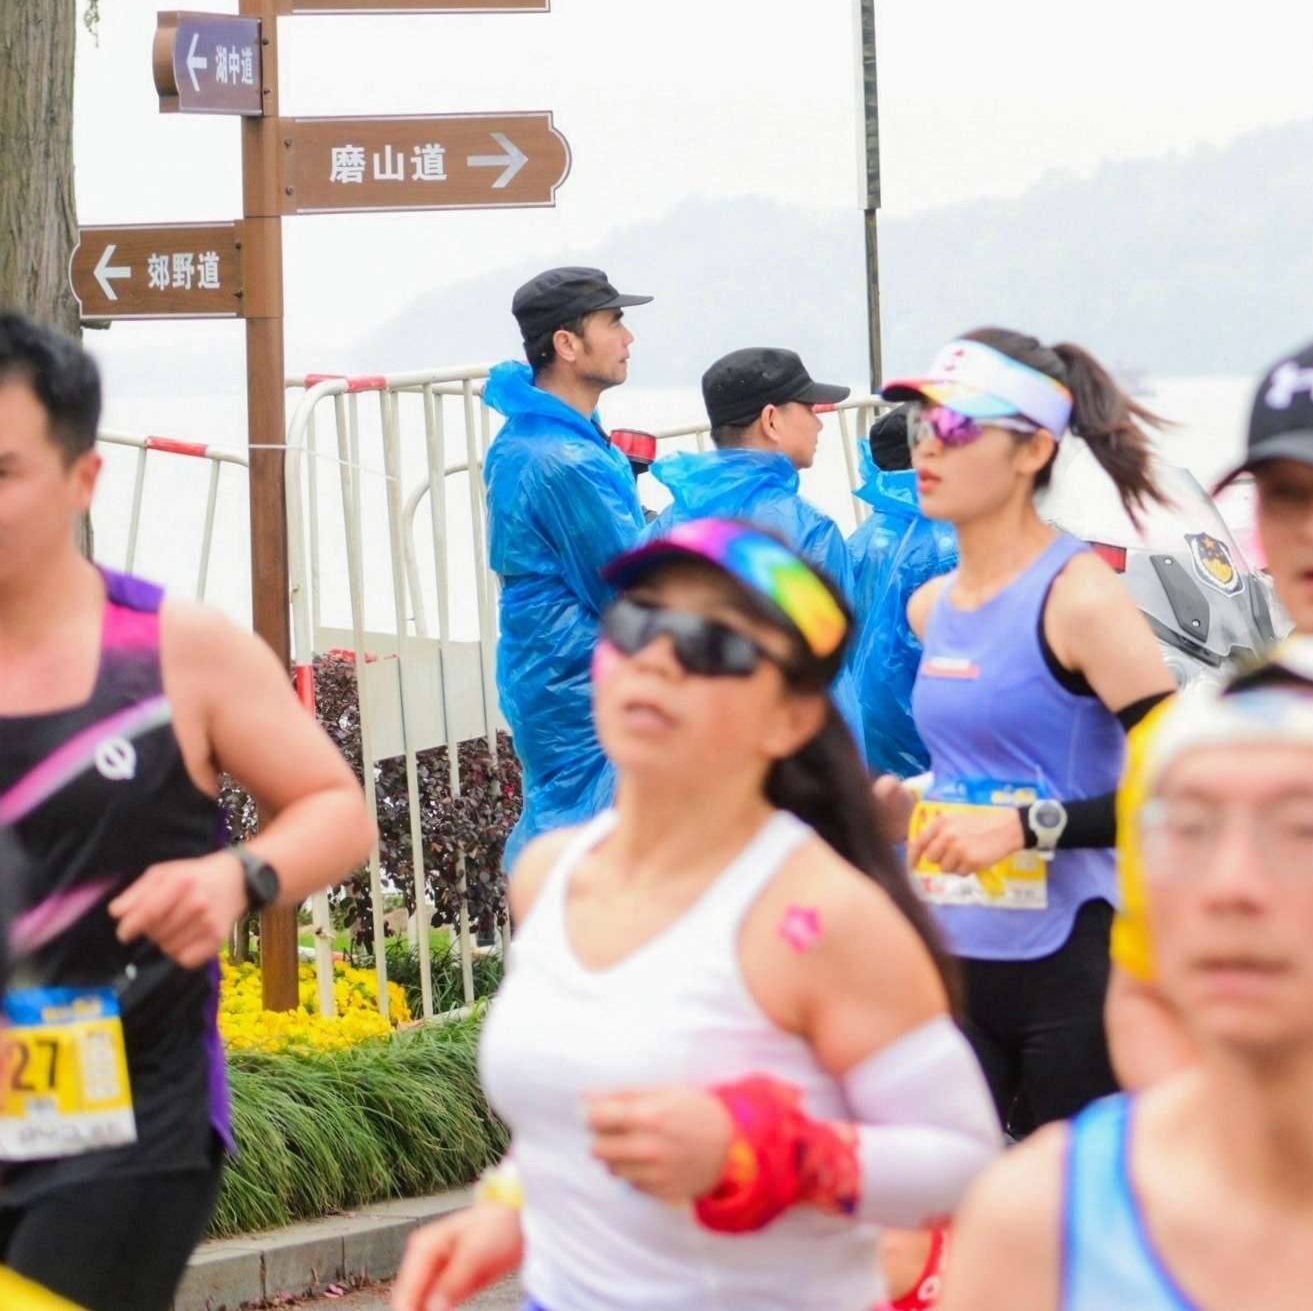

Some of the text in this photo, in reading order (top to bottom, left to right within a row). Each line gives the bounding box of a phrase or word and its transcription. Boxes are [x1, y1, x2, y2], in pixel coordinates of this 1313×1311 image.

[215, 45, 254, 86] 湖中道
[330, 143, 447, 183] 磨山道
[147, 251, 221, 290] 郊野道
